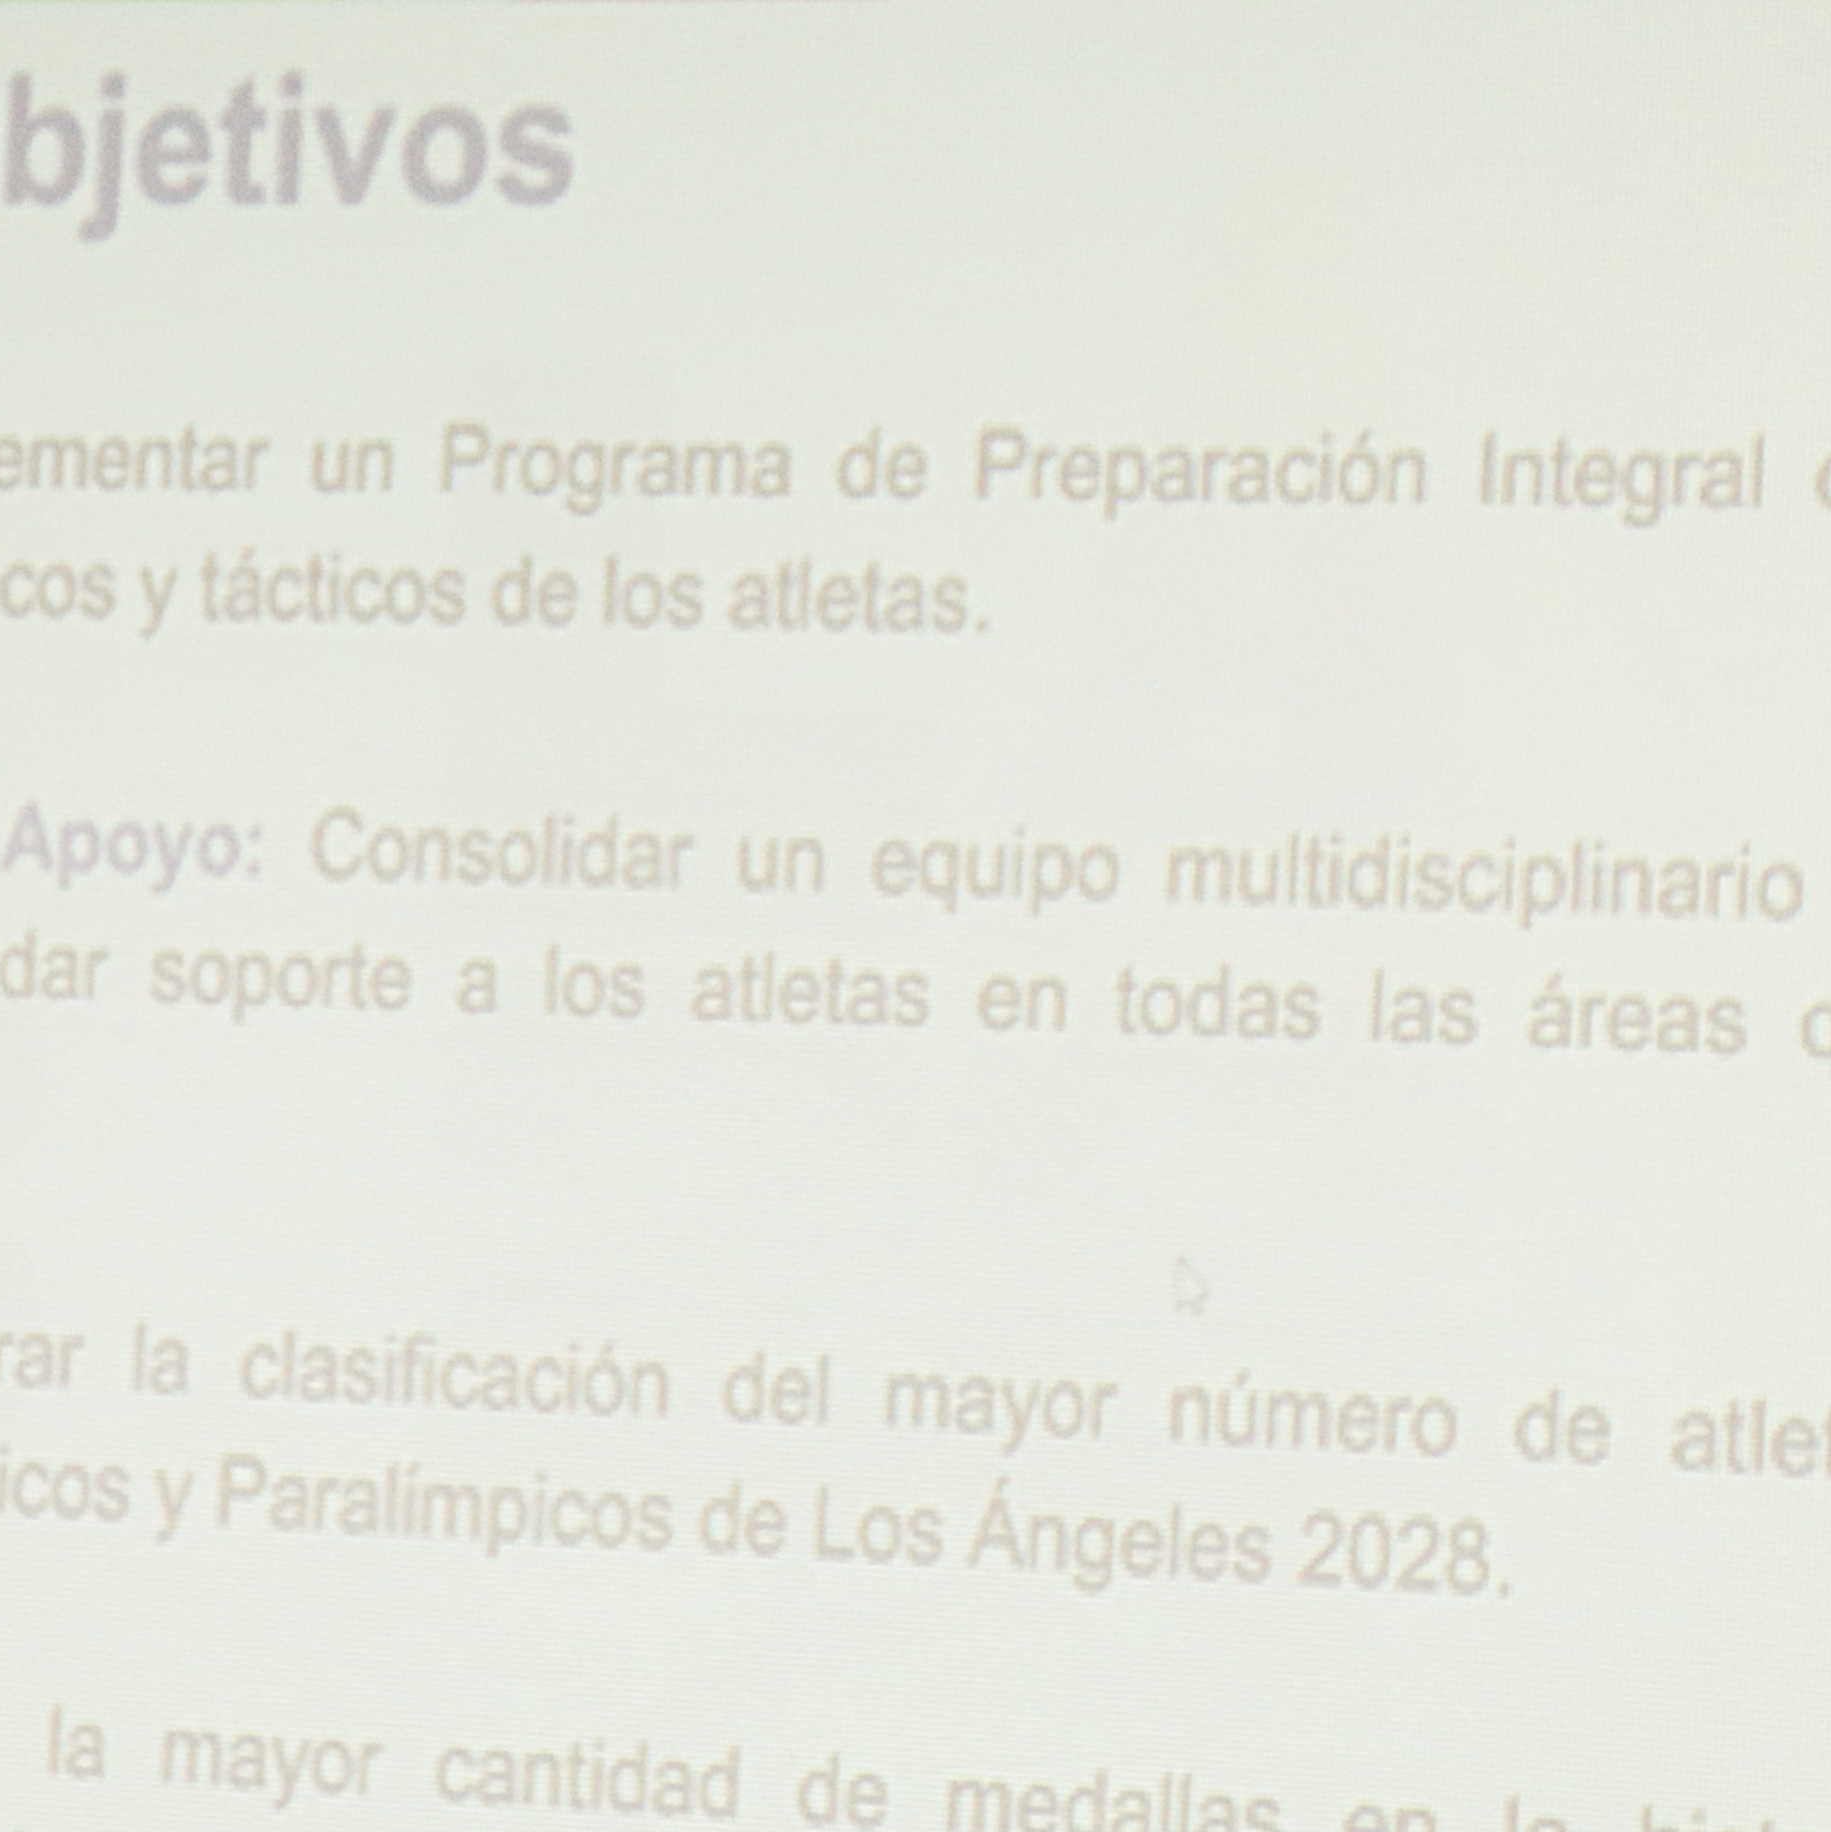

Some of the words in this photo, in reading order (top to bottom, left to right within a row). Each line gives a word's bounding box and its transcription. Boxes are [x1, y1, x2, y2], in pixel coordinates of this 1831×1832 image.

[311, 439, 394, 494] un
[441, 422, 792, 517] Programa
[837, 428, 927, 501] de
[975, 426, 1426, 520] Preparación
[1480, 432, 1765, 529] Integral
[140, 567, 178, 639] y
[201, 548, 466, 626] tácticos
[491, 555, 578, 628] de
[603, 555, 703, 629] los
[728, 559, 987, 634] atletas.
[1, 802, 261, 894] Apoyo:
[311, 806, 694, 889] Consolidar
[739, 838, 824, 893] un
[872, 828, 1119, 915] equipo
[1167, 833, 1803, 930] multidisciplinario
[152, 945, 411, 1023] soporte
[457, 960, 496, 1014] a
[546, 945, 644, 1018] los
[691, 952, 929, 1027] atletas
[977, 976, 1066, 1031] en
[1117, 964, 1320, 1041] todas
[1372, 970, 1478, 1045] las
[1528, 973, 1747, 1055] áreas
[134, 1324, 187, 1394] la
[241, 1331, 669, 1416] clasificación
[723, 1352, 829, 1425] del
[886, 1373, 1118, 1455] mayor
[1169, 1371, 1457, 1457] número
[1514, 1389, 1610, 1465] de
[156, 1471, 193, 1542] y
[218, 1453, 673, 1557] Paralímpicos
[700, 1483, 786, 1557] de
[816, 1487, 943, 1566] Los
[968, 1477, 1271, 1594] Ángeles
[1299, 1510, 1510, 1597] 2028.
[49, 1706, 104, 1779] la
[162, 1731, 383, 1810] mayor
[436, 1742, 740, 1819] cantidad
[798, 1754, 887, 1831] de
